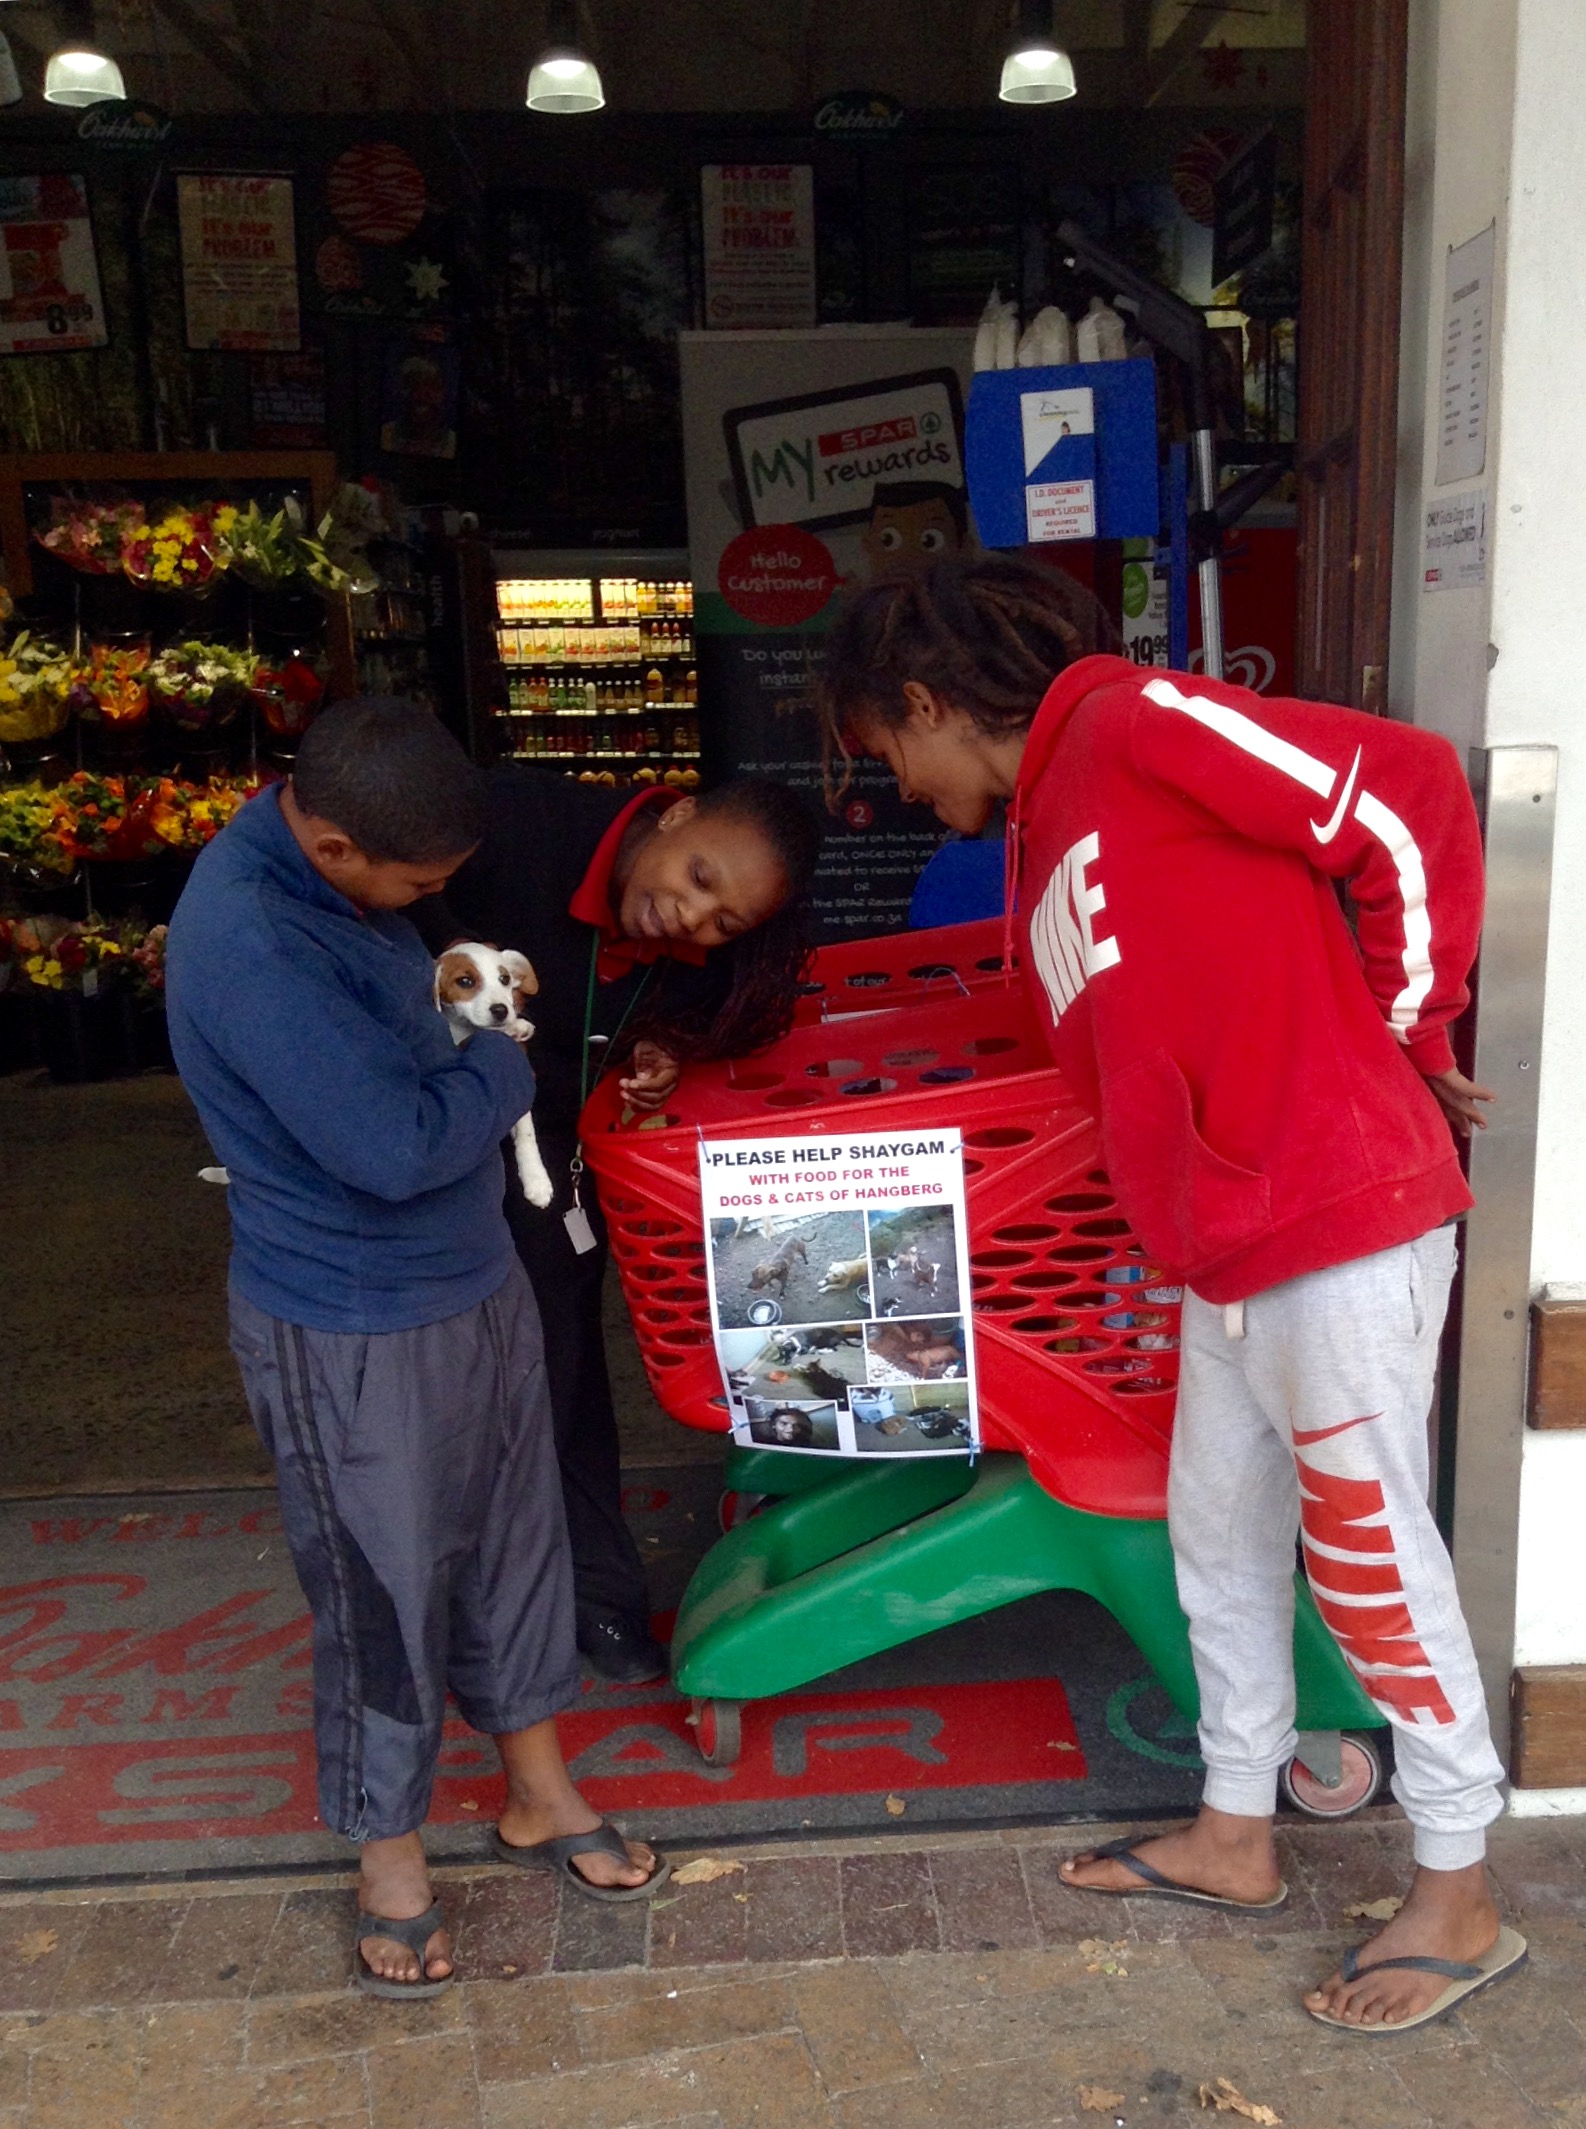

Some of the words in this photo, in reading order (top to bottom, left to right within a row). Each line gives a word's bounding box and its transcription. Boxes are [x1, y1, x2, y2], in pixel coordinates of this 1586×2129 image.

[751, 438, 816, 502] MY
[840, 420, 916, 450] SPAR
[823, 439, 951, 485] rewards
[1048, 485, 1084, 496] DOCUMENT
[1063, 505, 1090, 516] LICENCE
[749, 551, 803, 571] Hello
[771, 649, 802, 666] you
[853, 806, 867, 823] 2
[1029, 831, 1122, 1028] NIKE
[712, 1150, 787, 1167] PLEASE
[792, 1146, 843, 1163] HELP
[849, 1141, 946, 1160] SHAYGAM
[749, 1173, 790, 1186] WITH
[795, 1169, 838, 1183] FOOD
[843, 1168, 875, 1181] FOR
[879, 1166, 910, 1179] THE
[720, 1193, 763, 1207] DOGS
[769, 1192, 779, 1204] &
[784, 1189, 825, 1204] CATS
[829, 1188, 850, 1202] OF
[855, 1182, 943, 1200] HANGBERG
